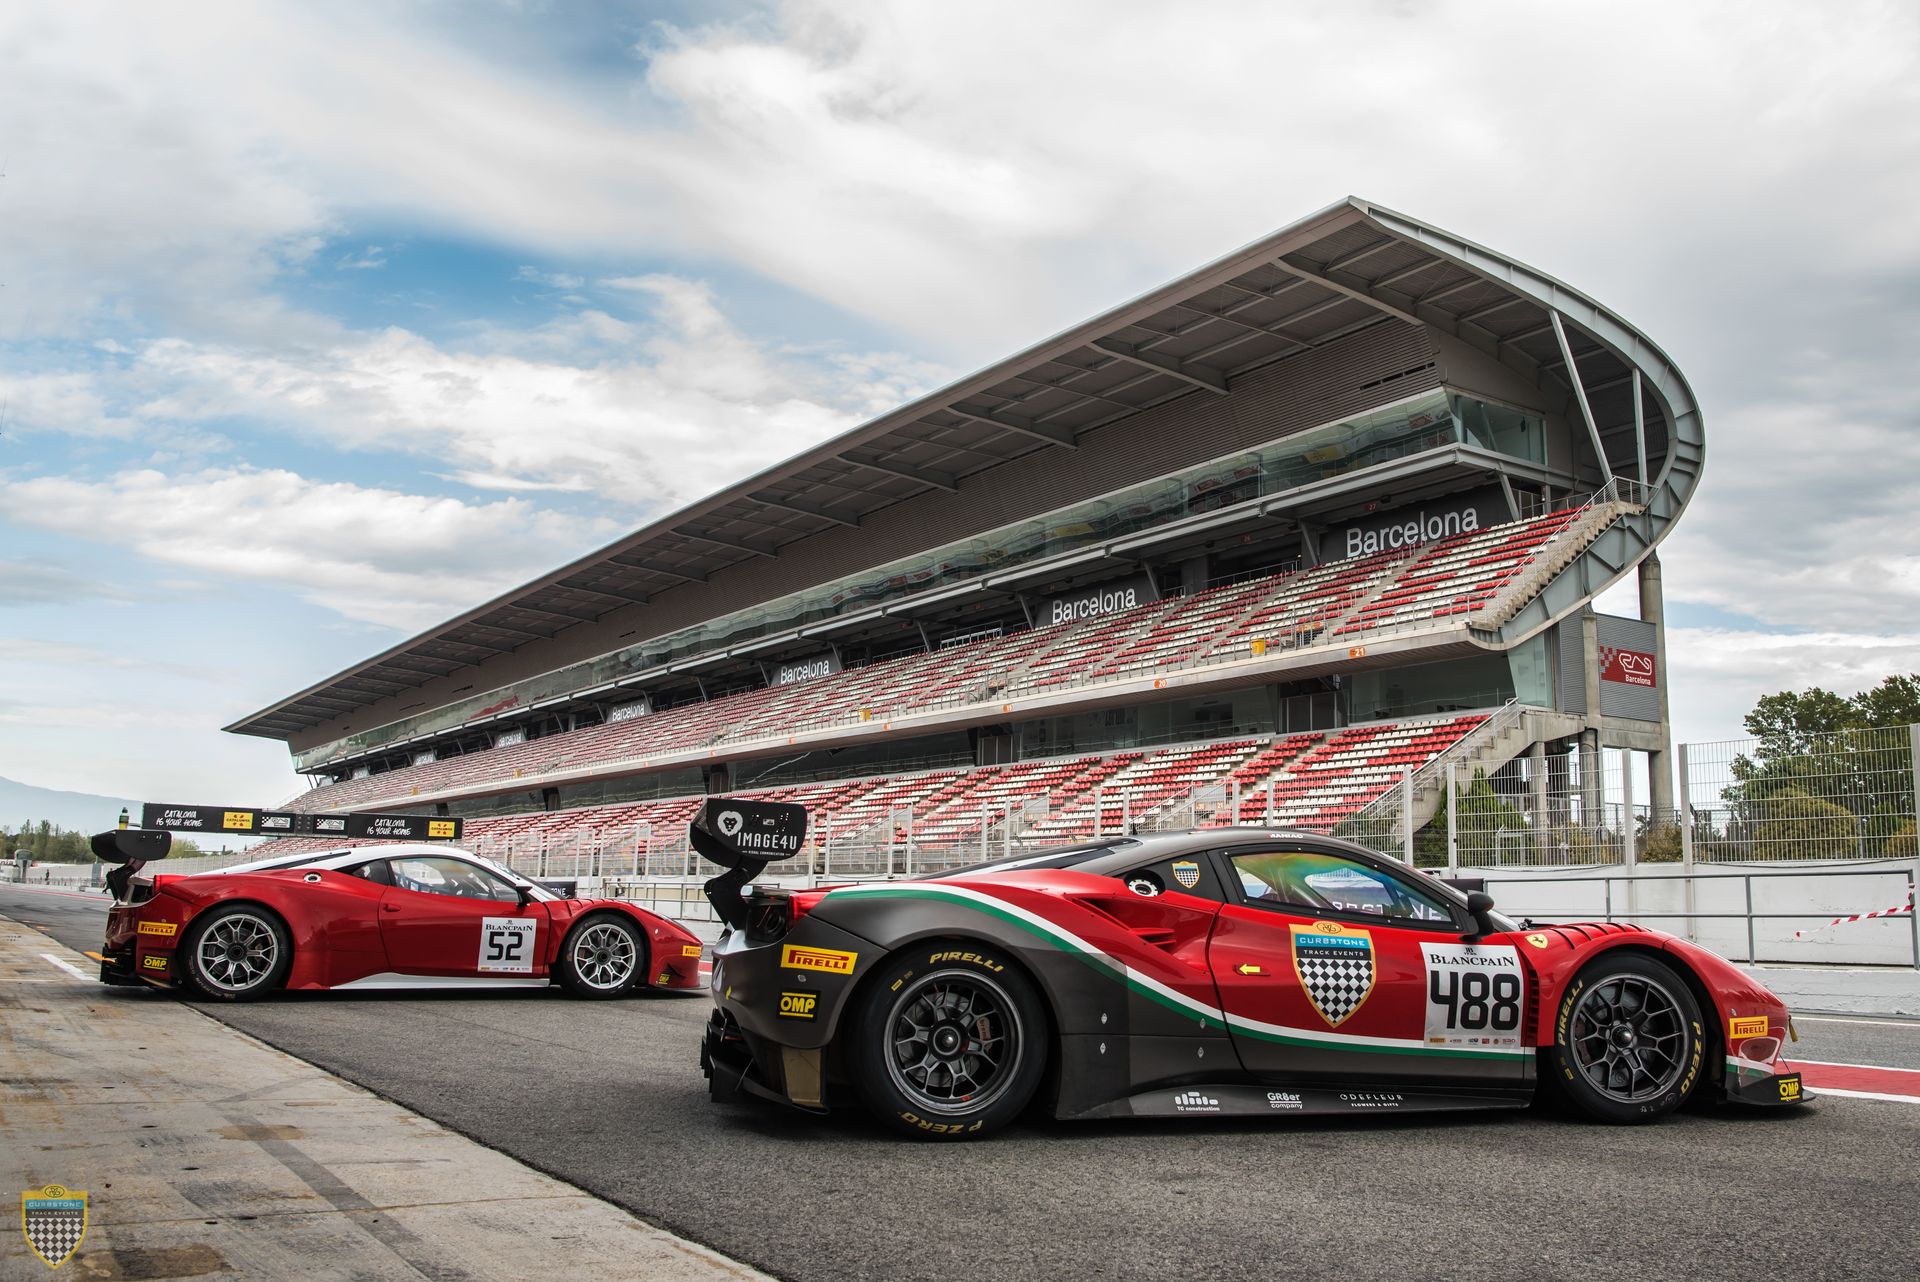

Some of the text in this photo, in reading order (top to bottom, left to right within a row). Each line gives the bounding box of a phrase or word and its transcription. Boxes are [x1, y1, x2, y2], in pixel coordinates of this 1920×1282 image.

[1346, 507, 1479, 558] Barcelona
[1052, 587, 1136, 624] Barcelona
[780, 659, 830, 684] Barcelona
[1625, 674, 1651, 686] Barcelona
[612, 703, 645, 721] Barcelona
[166, 818, 182, 826] YOUR
[183, 819, 203, 827] HOME
[376, 827, 391, 835] YOUR
[392, 827, 411, 836] HOME
[737, 831, 798, 850] IMAGE4U
[485, 924, 533, 932] BLANCPAIN
[487, 931, 523, 961] 52
[1299, 937, 1366, 947] CURBSTONE
[144, 958, 167, 968] OMP
[788, 949, 850, 970] PIRELLI
[929, 951, 1004, 973] PIRELLI
[1429, 953, 1515, 967] BLANCPAIN
[780, 996, 816, 1014] OMP
[1430, 970, 1520, 1031] 488
[1558, 979, 1584, 1046] PIRELLI
[1734, 1020, 1765, 1035] PIRELLI
[1680, 1021, 1702, 1094] P ZERO
[1267, 1092, 1301, 1101] GR8er
[1779, 1081, 1799, 1096] OMP
[1270, 1102, 1303, 1110] company
[901, 1111, 984, 1134] P ZERO
